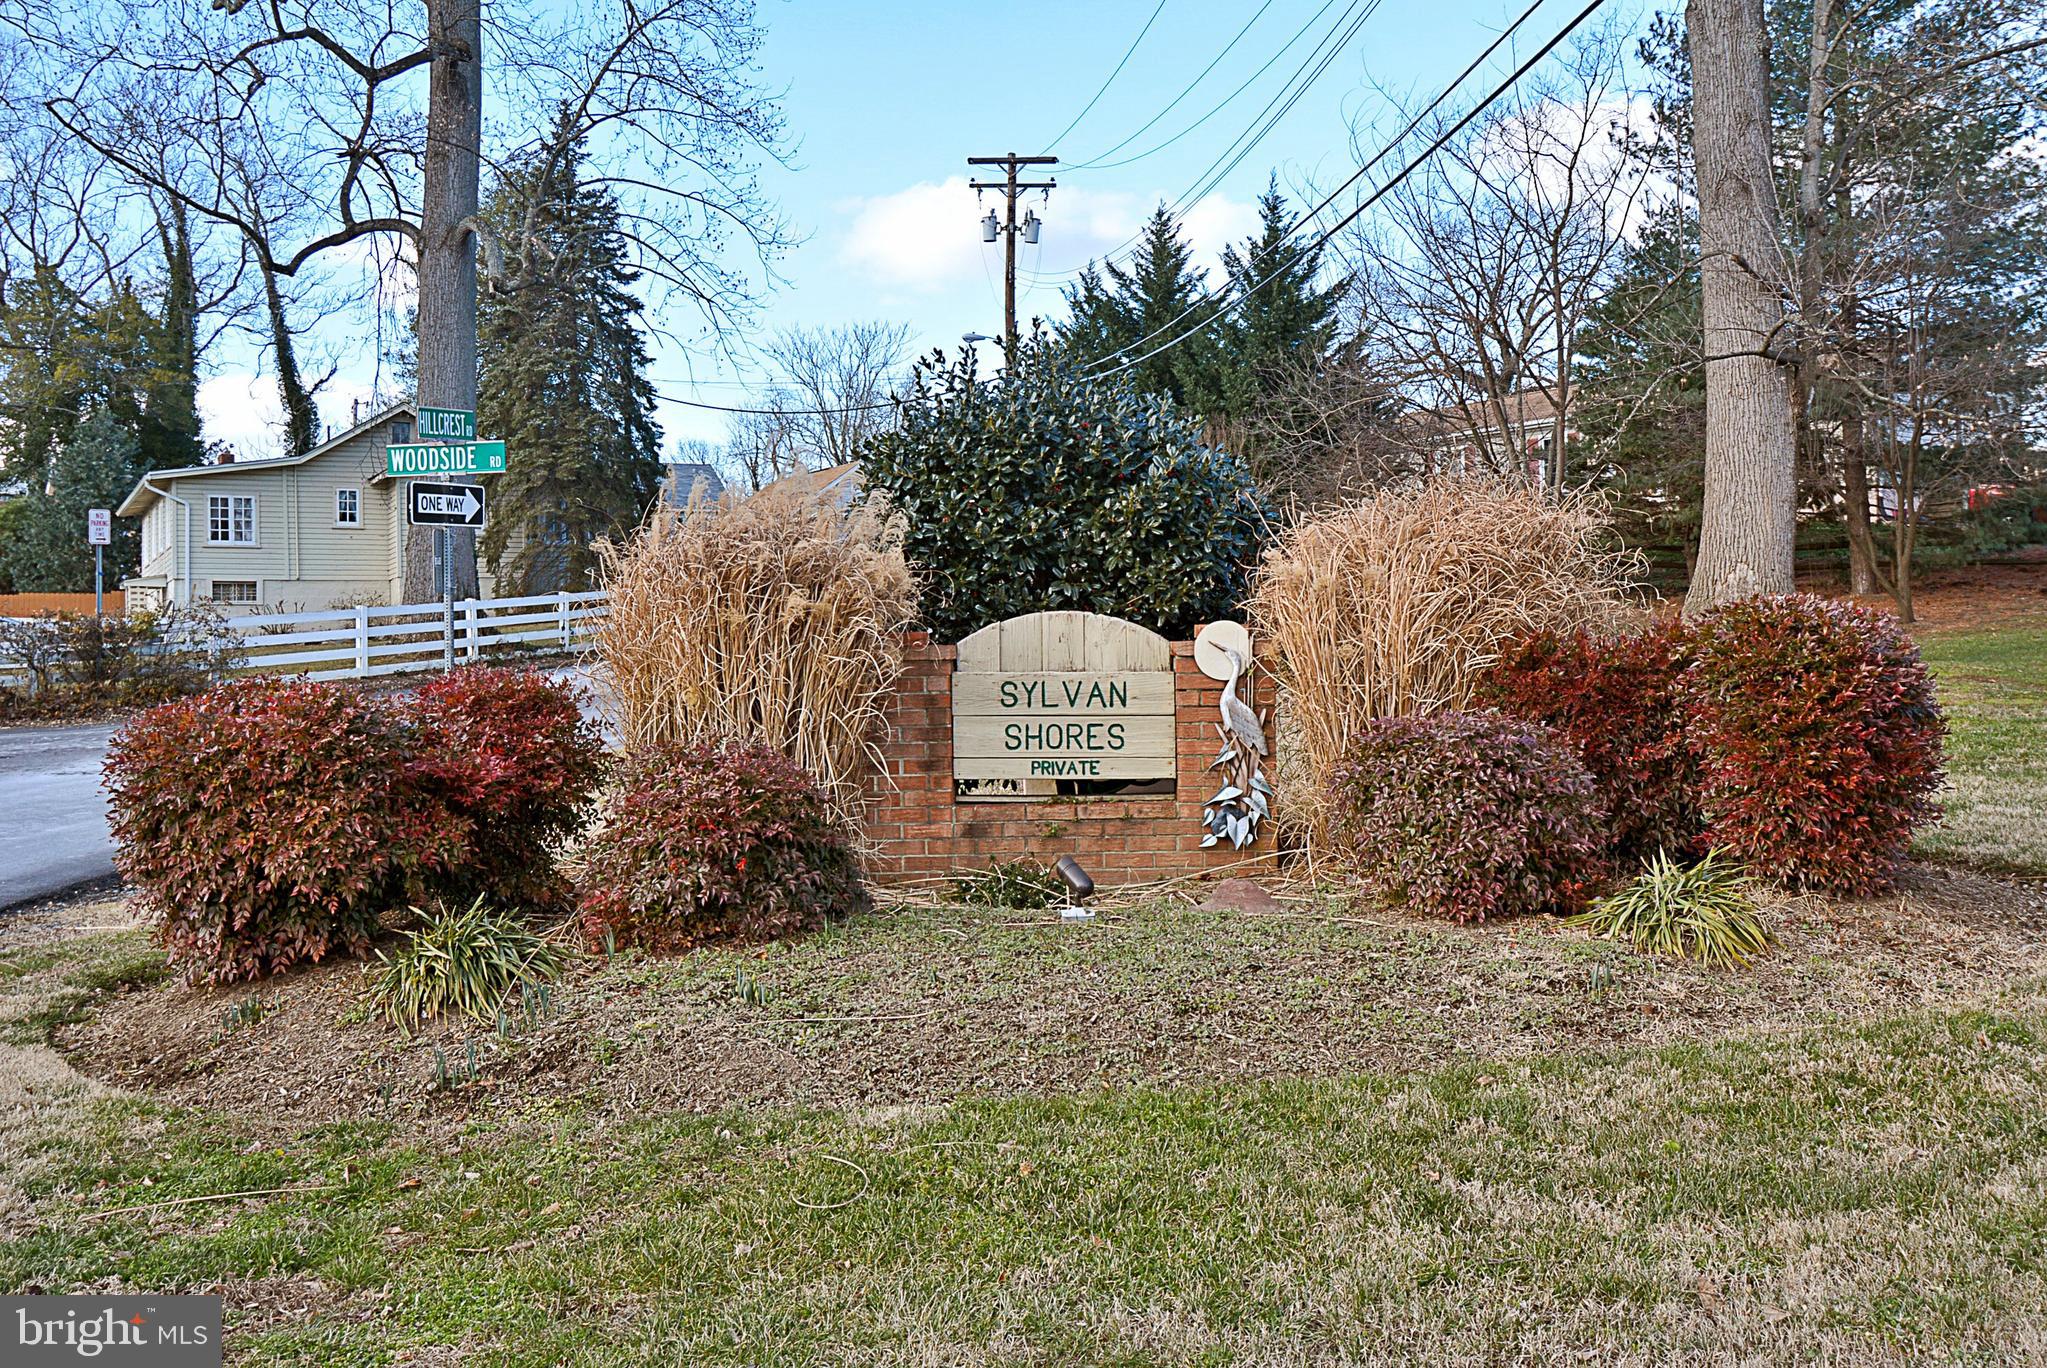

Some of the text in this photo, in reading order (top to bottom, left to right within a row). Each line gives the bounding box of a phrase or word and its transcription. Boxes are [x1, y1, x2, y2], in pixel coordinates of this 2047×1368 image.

[420, 411, 473, 437] HILLCREST RD
[391, 446, 501, 471] WOODSIDE RD
[421, 495, 465, 513] ONE WAY
[1000, 680, 1127, 708] SYLVAN
[1005, 724, 1125, 750] SHORES
[1031, 760, 1100, 776] PRIVATE
